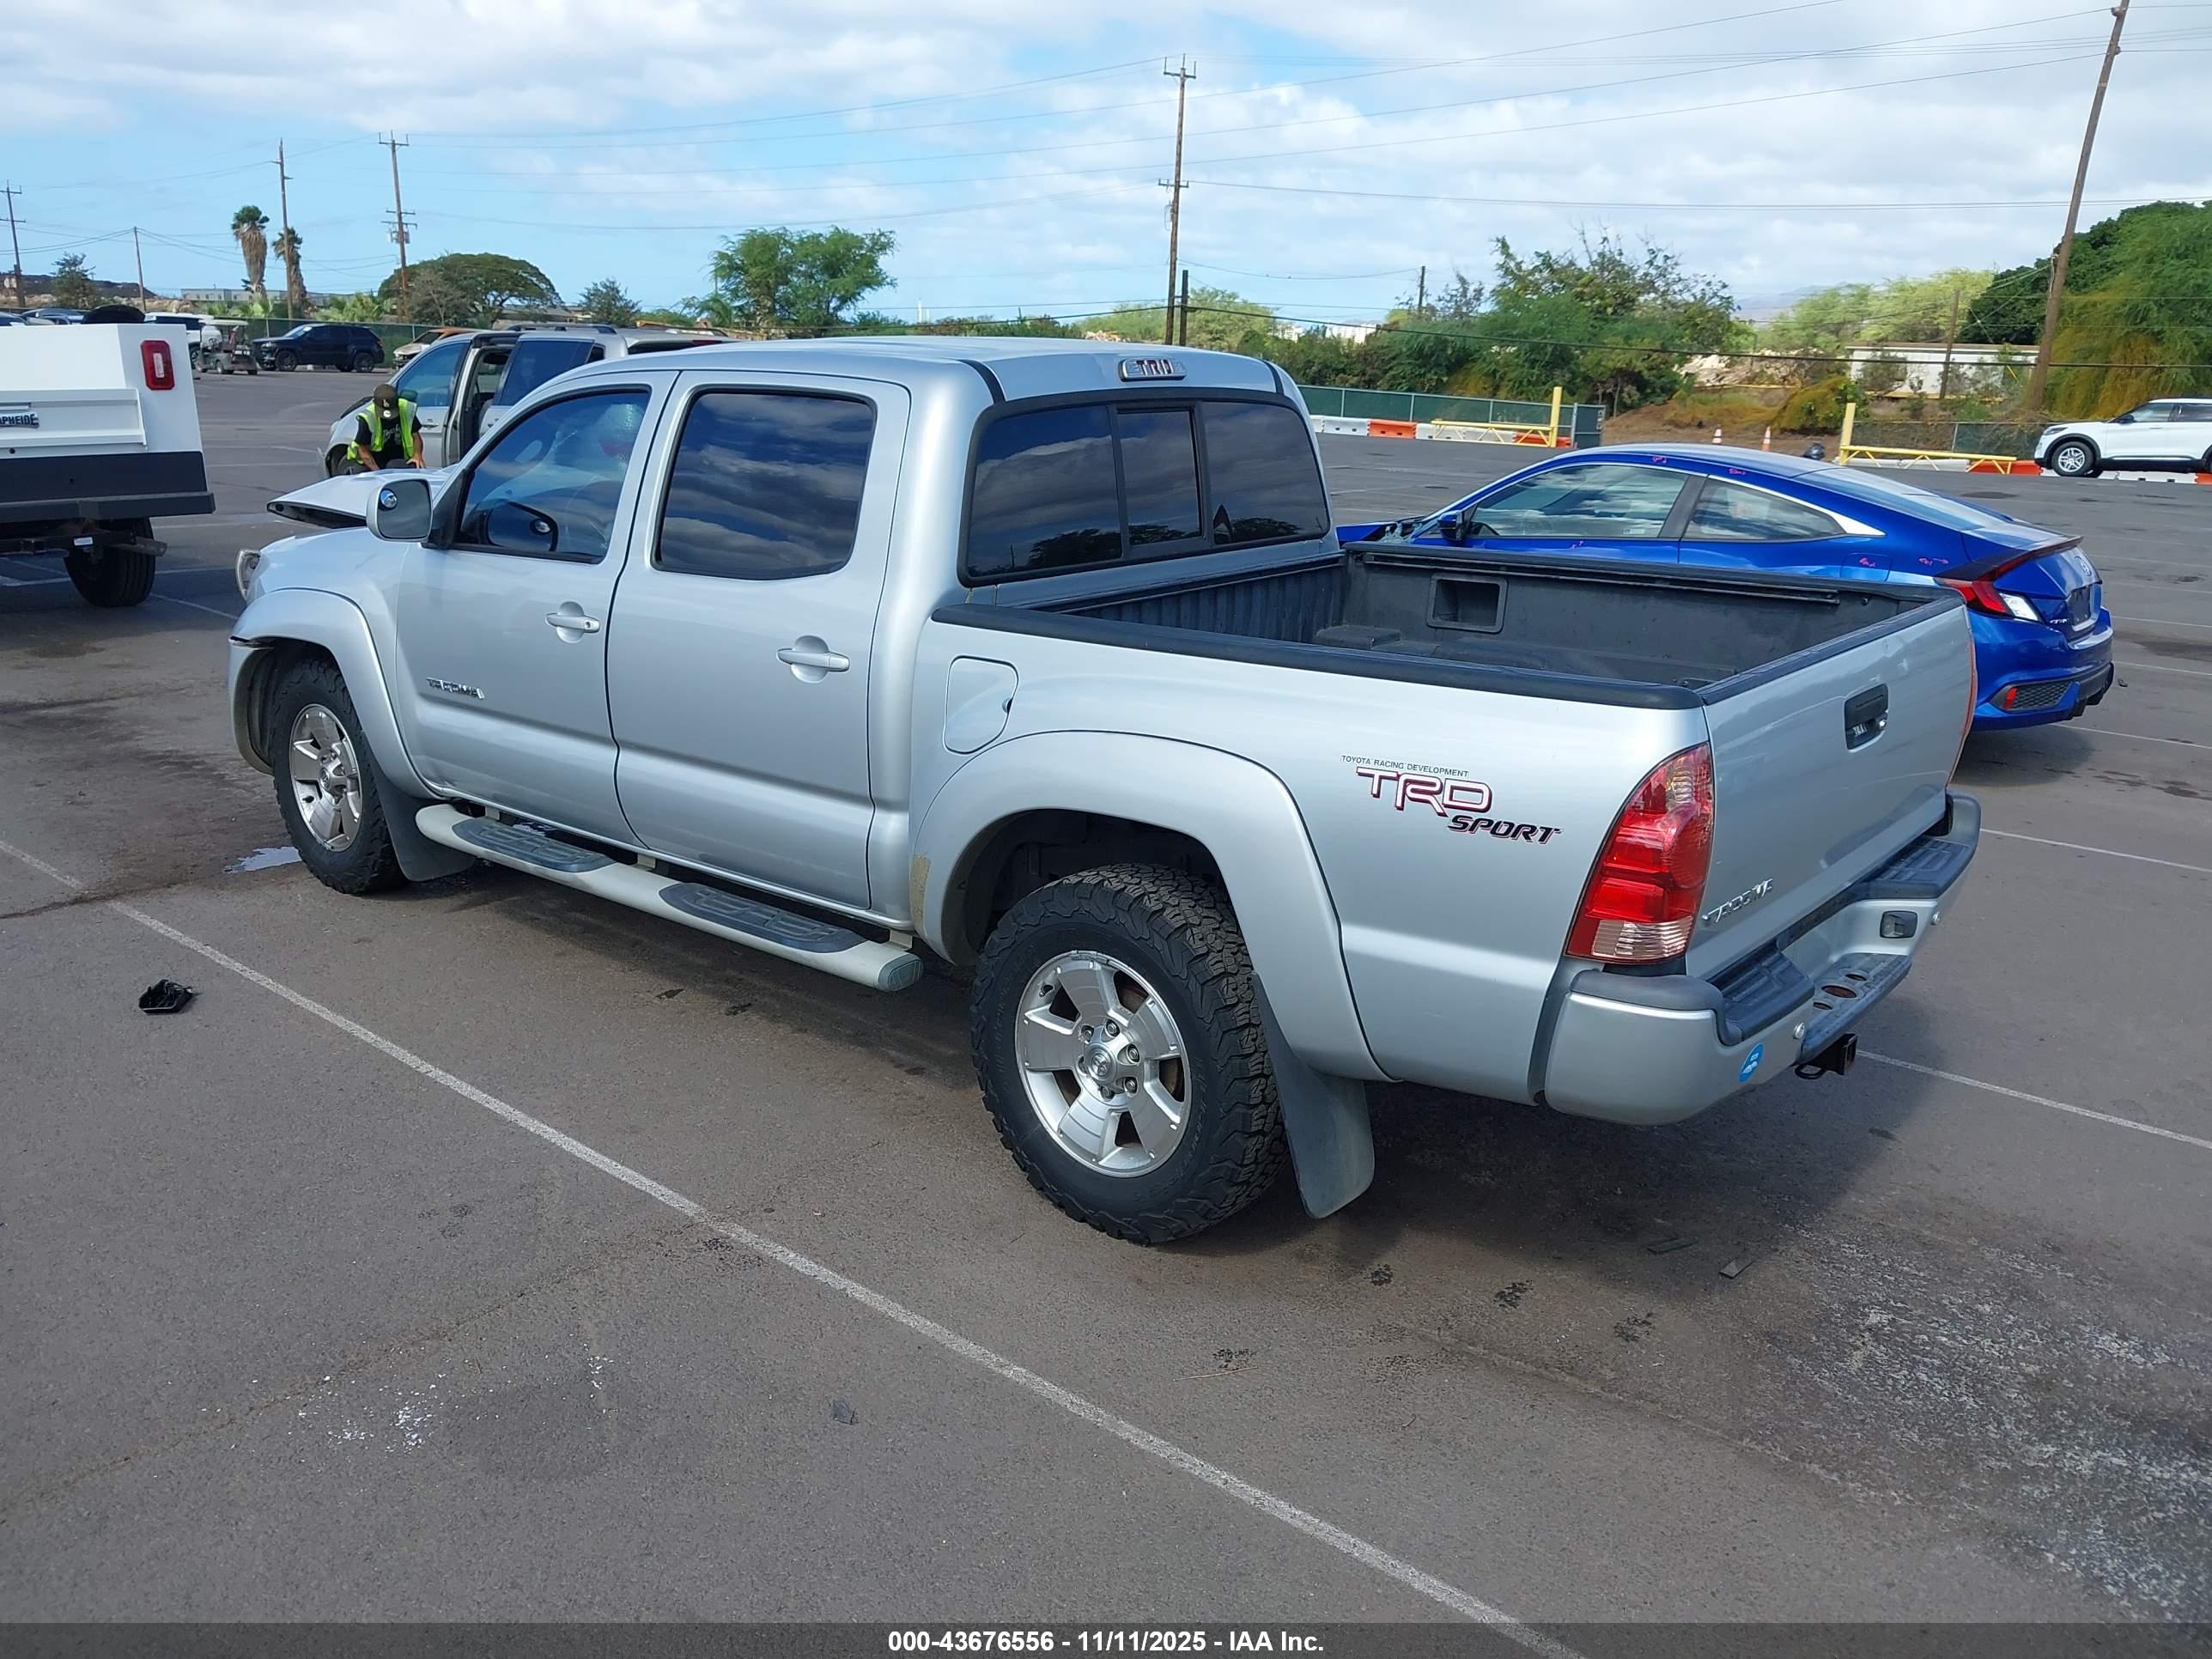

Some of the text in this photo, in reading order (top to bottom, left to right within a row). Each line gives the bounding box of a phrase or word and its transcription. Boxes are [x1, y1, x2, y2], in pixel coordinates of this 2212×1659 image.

[1340, 755, 1469, 779] TOYOTA RACING DEVELOPMENT
[1356, 766, 1493, 818] TRD
[1447, 814, 1563, 845] SPORT
